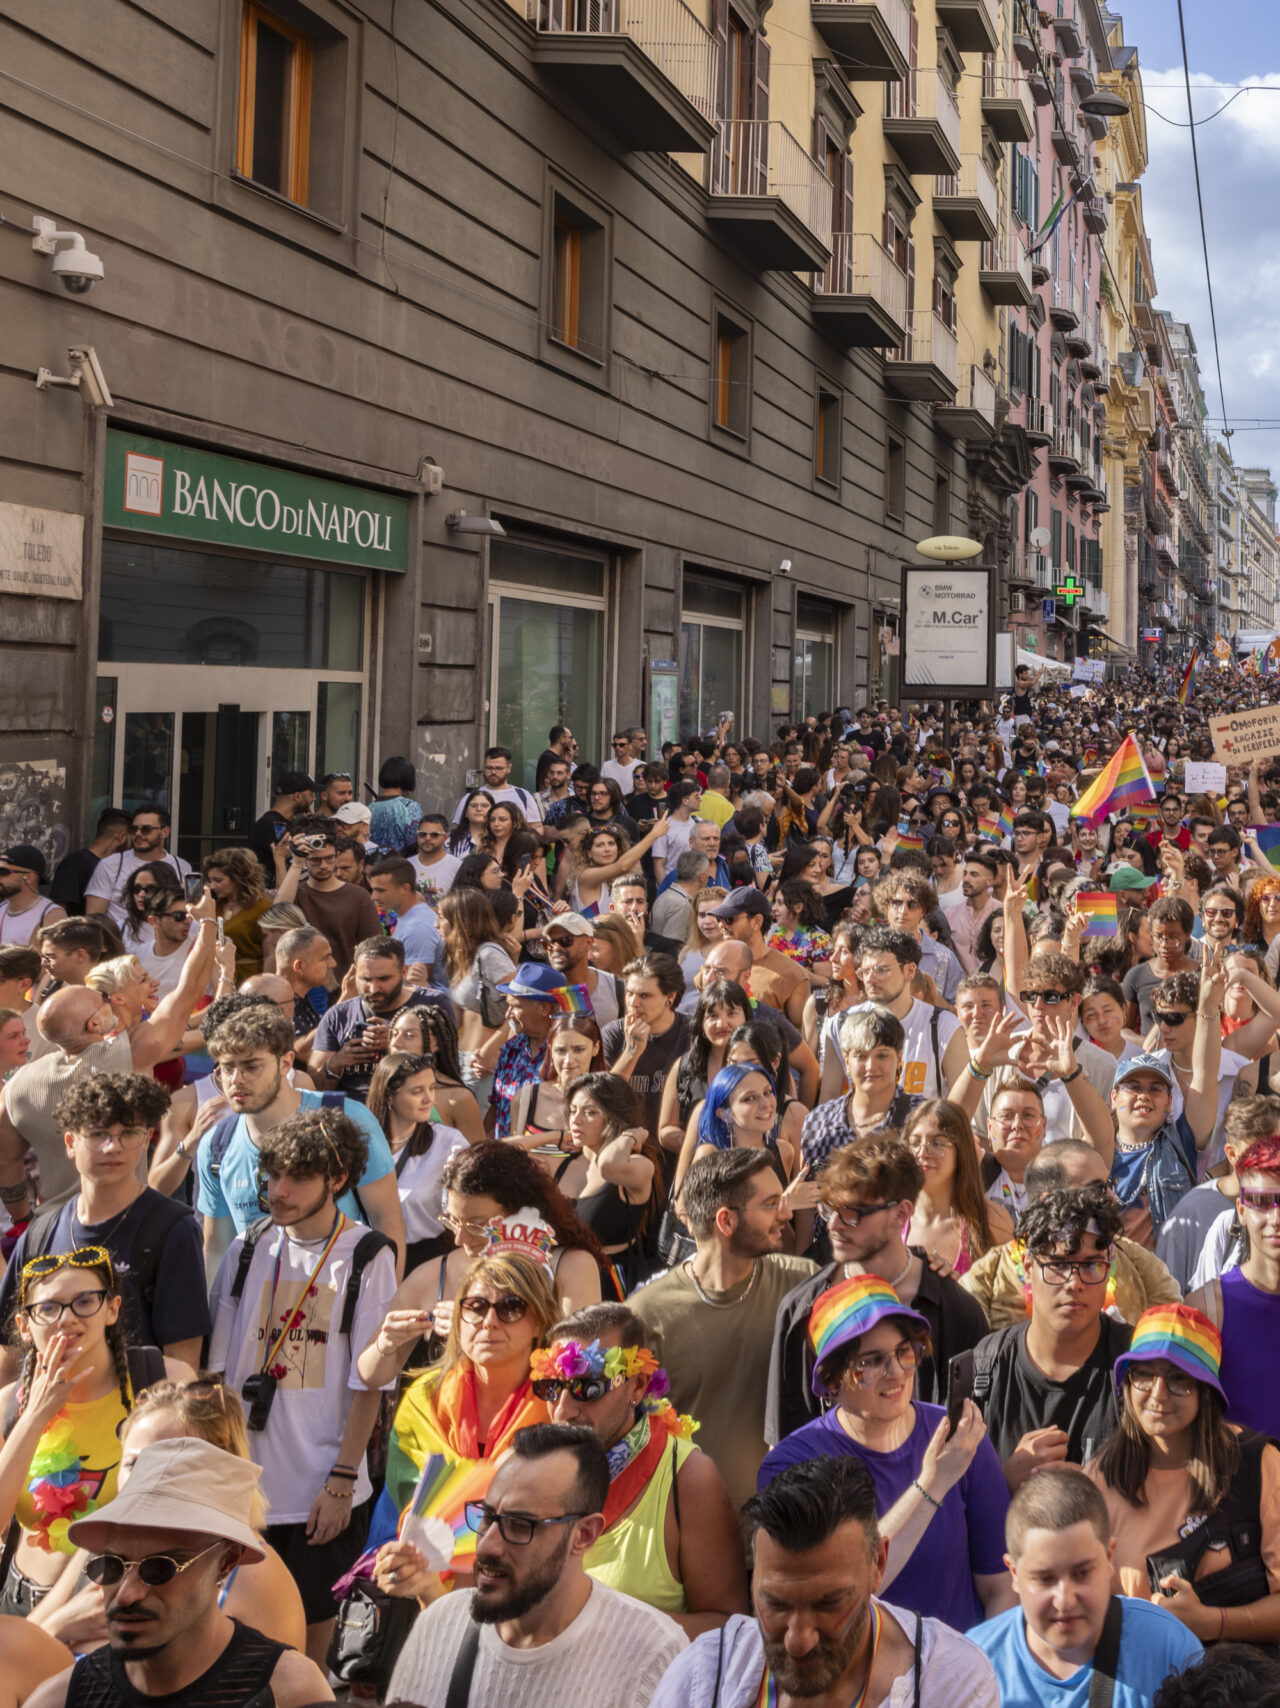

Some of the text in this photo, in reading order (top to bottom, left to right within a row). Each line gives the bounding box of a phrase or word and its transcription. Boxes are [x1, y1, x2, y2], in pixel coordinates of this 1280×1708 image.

[172, 469, 393, 552] BANCO DI NAPOLI
[31, 519, 45, 534] VIA
[23, 542, 52, 563] TOLEDO
[934, 592, 976, 600] MOTORRAD
[932, 610, 979, 625] M.Car
[1233, 727, 1275, 744] RAGAZZE
[501, 1223, 547, 1247] LOVE
